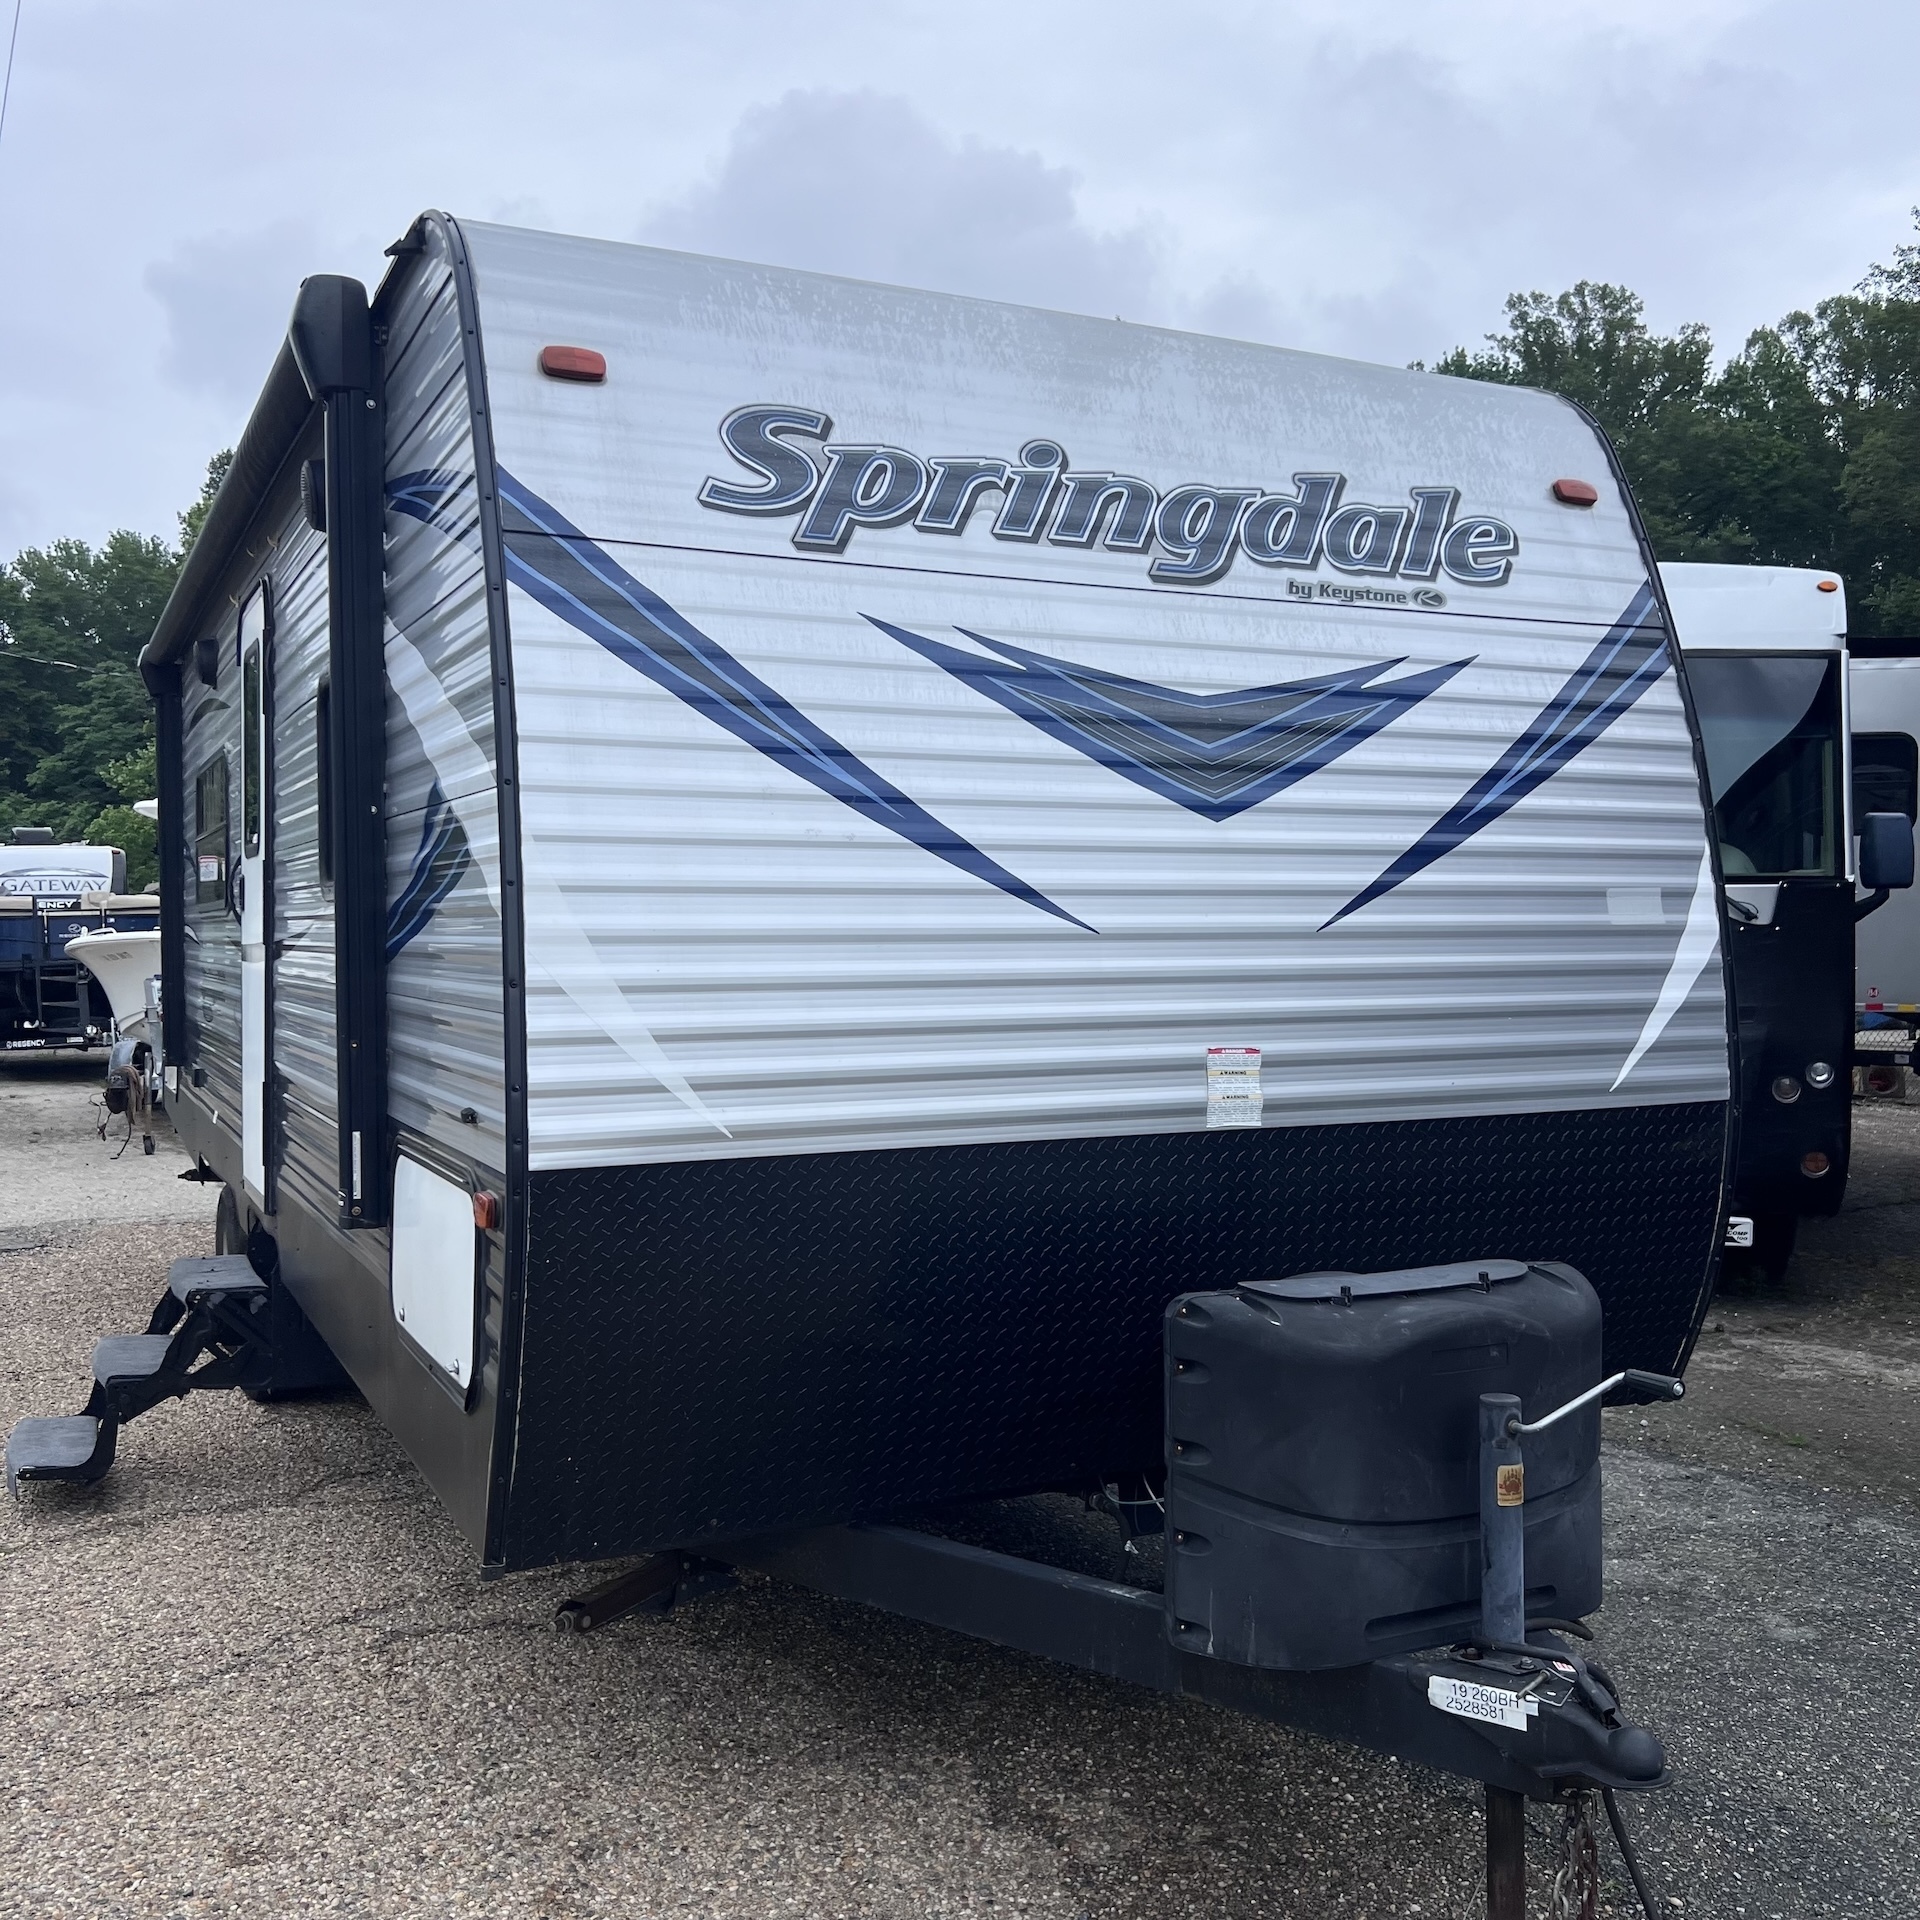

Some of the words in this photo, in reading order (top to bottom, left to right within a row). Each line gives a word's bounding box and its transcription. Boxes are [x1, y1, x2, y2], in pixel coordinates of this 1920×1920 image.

[697, 403, 1520, 585] Springdale
[1288, 581, 1312, 599] by
[1319, 584, 1407, 603] Keystone
[2, 879, 107, 892] GATEWAY
[12, 1039, 45, 1048] REGENCY
[1446, 1695, 1504, 1720] 2528581
[1452, 1683, 1468, 1698] 19
[1472, 1686, 1519, 1709] 260BH
